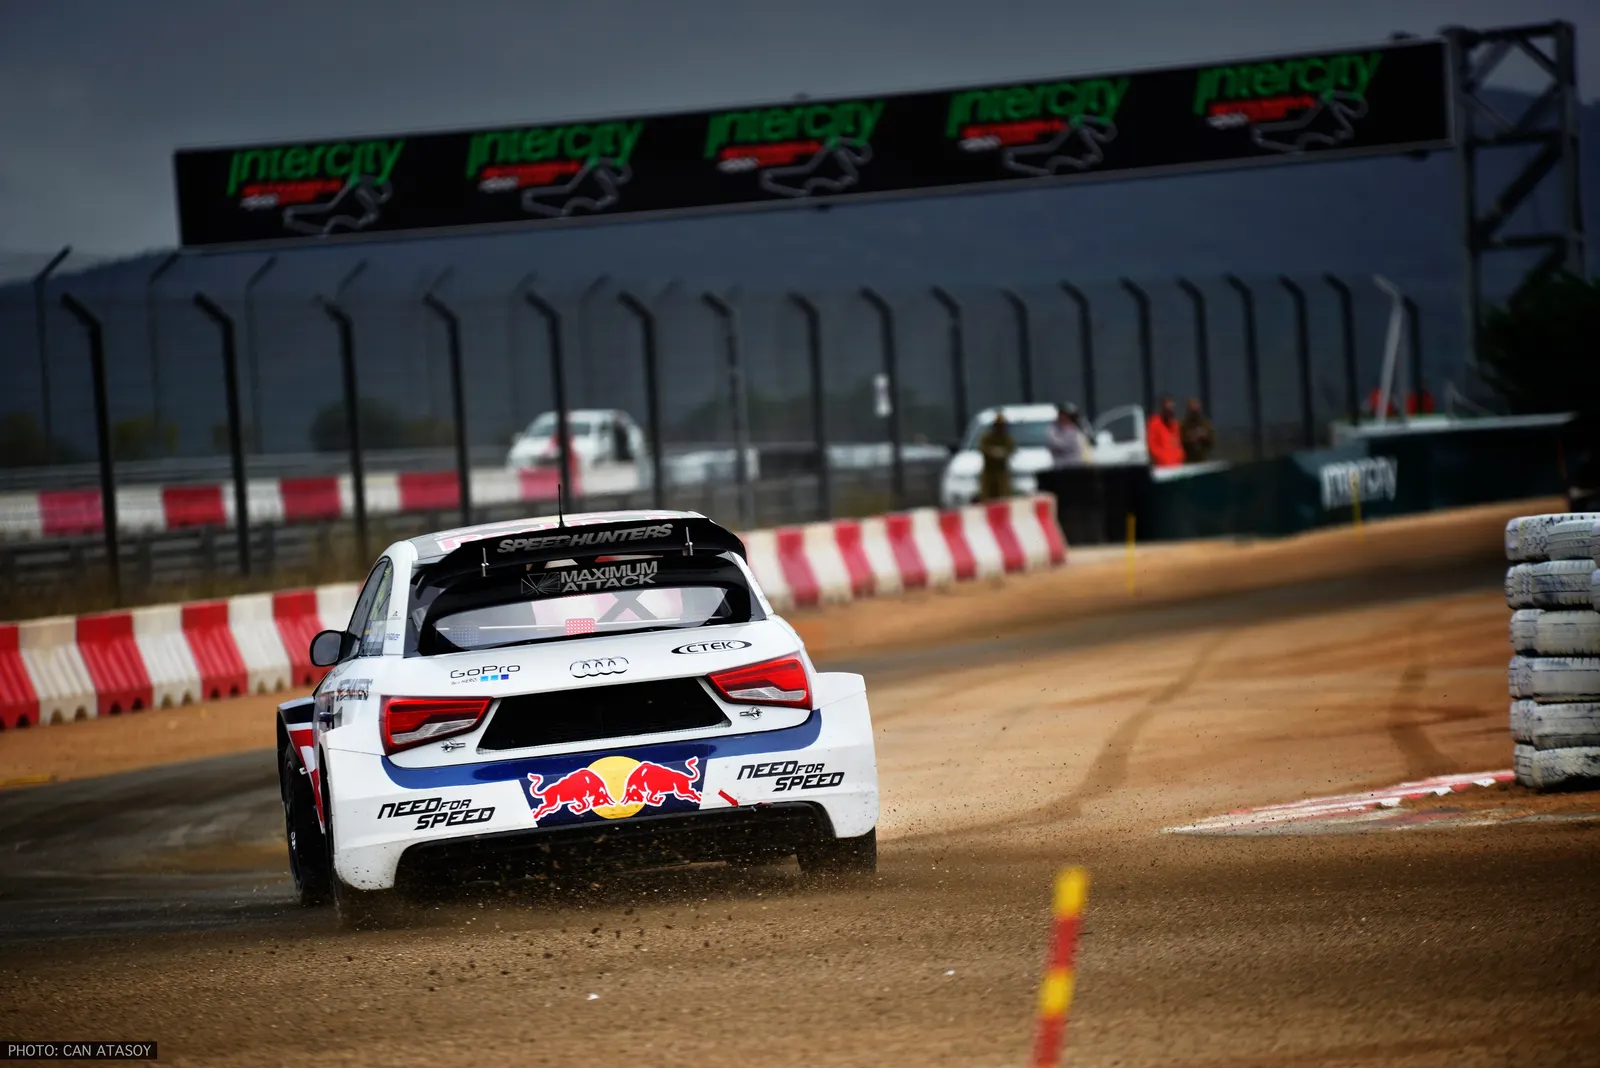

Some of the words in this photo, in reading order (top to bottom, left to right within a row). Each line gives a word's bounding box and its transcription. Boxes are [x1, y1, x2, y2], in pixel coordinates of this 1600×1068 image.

[497, 523, 674, 553] SPEEDHUNTERS
[560, 561, 658, 583] MAXIMUM
[561, 573, 656, 593] ATTACK
[686, 641, 734, 653] CTEK
[450, 665, 521, 679] GoPro
[736, 760, 798, 780] NEED
[795, 763, 825, 775] FOR
[772, 772, 845, 792] SPEED
[377, 797, 442, 819] NEED
[438, 799, 472, 812] FOR
[414, 807, 495, 830] SPEED
